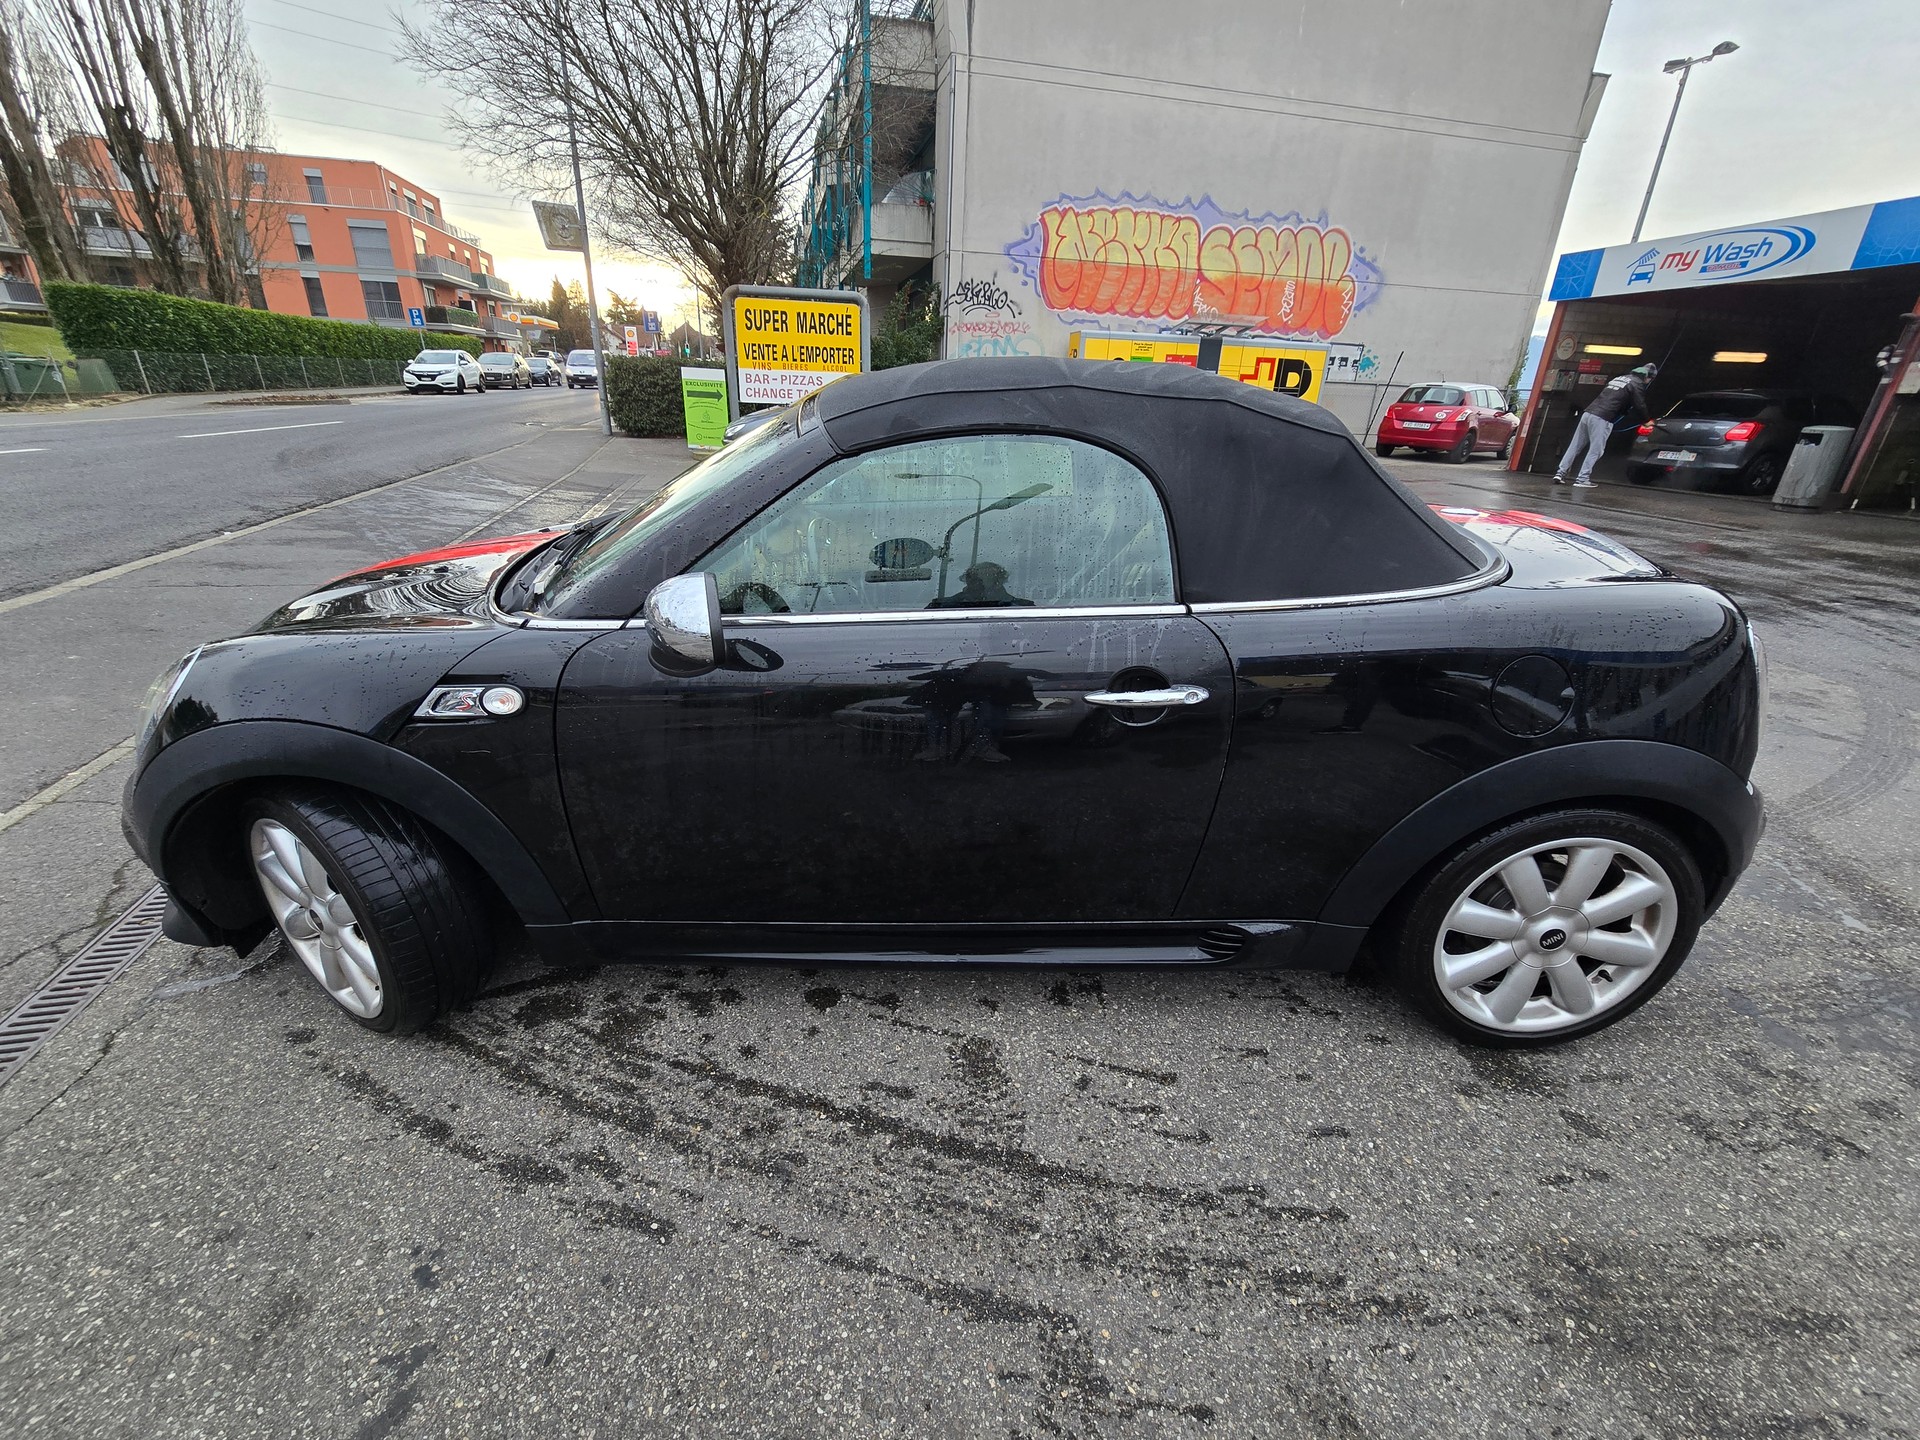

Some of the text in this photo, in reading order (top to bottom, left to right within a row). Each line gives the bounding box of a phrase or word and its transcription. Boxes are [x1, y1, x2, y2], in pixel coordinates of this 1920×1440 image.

[1659, 237, 1773, 272] my Wash
[411, 309, 419, 318] P
[647, 312, 655, 323] P
[744, 307, 852, 336] SUPER MARCHÉ
[743, 342, 855, 365] VENTE A L'EMPORTER
[752, 361, 848, 372] VINS BIERES ALCOOL
[745, 387, 793, 399] CHANGE
[1542, 932, 1564, 947] MINI
